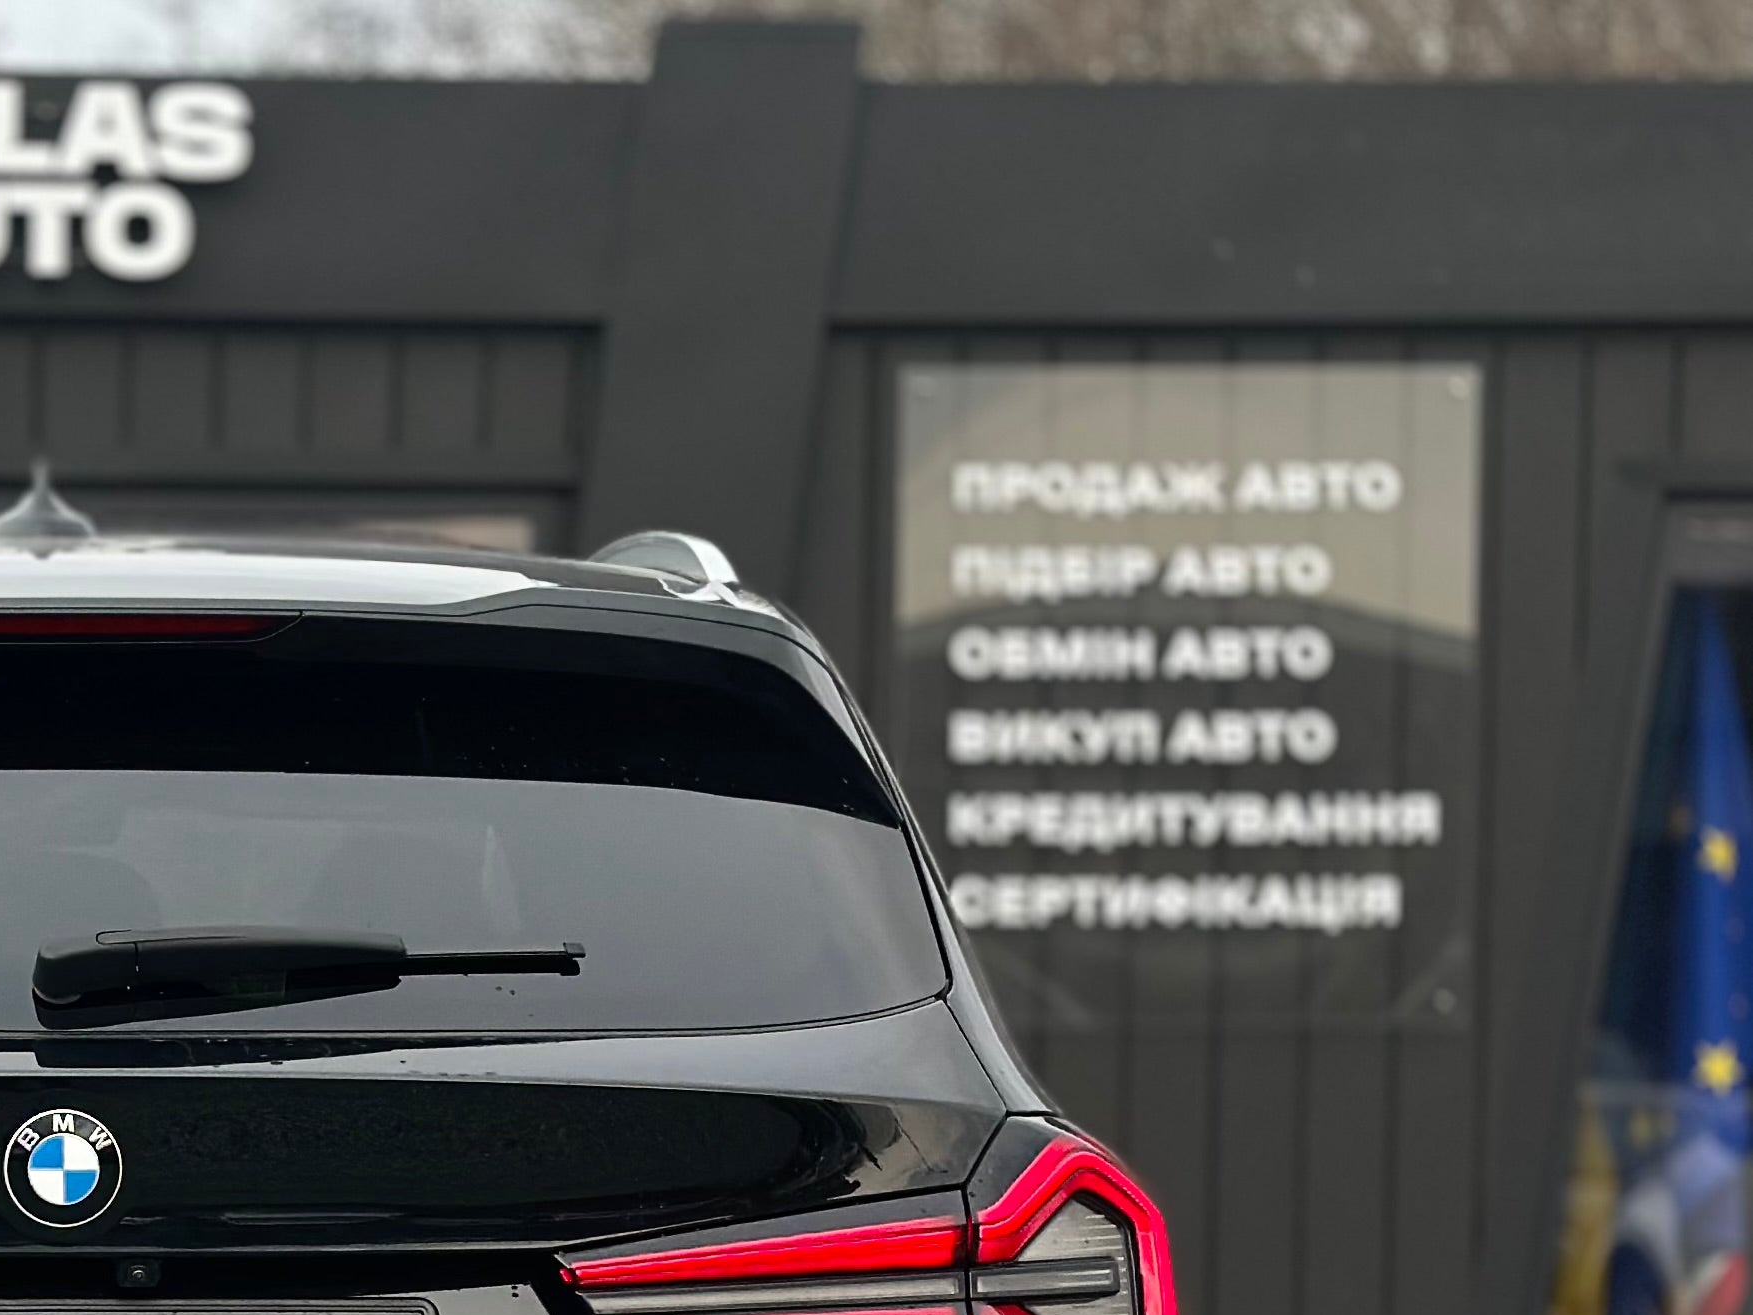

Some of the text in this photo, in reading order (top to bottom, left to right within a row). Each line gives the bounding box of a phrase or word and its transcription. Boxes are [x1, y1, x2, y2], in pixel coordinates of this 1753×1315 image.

[951, 461, 1404, 520] ПРОДАЖ АВТО
[951, 544, 1333, 604] ПІДБІР АВТО
[948, 626, 1335, 681] ОБМІН АВТО
[950, 708, 1338, 764] ВИКУП АВТО
[949, 791, 1442, 853] КРЕДИТУВАННЯ
[948, 873, 1403, 935] СЕРТИФІКАЦІЯ
[17, 1113, 113, 1151] BMW
